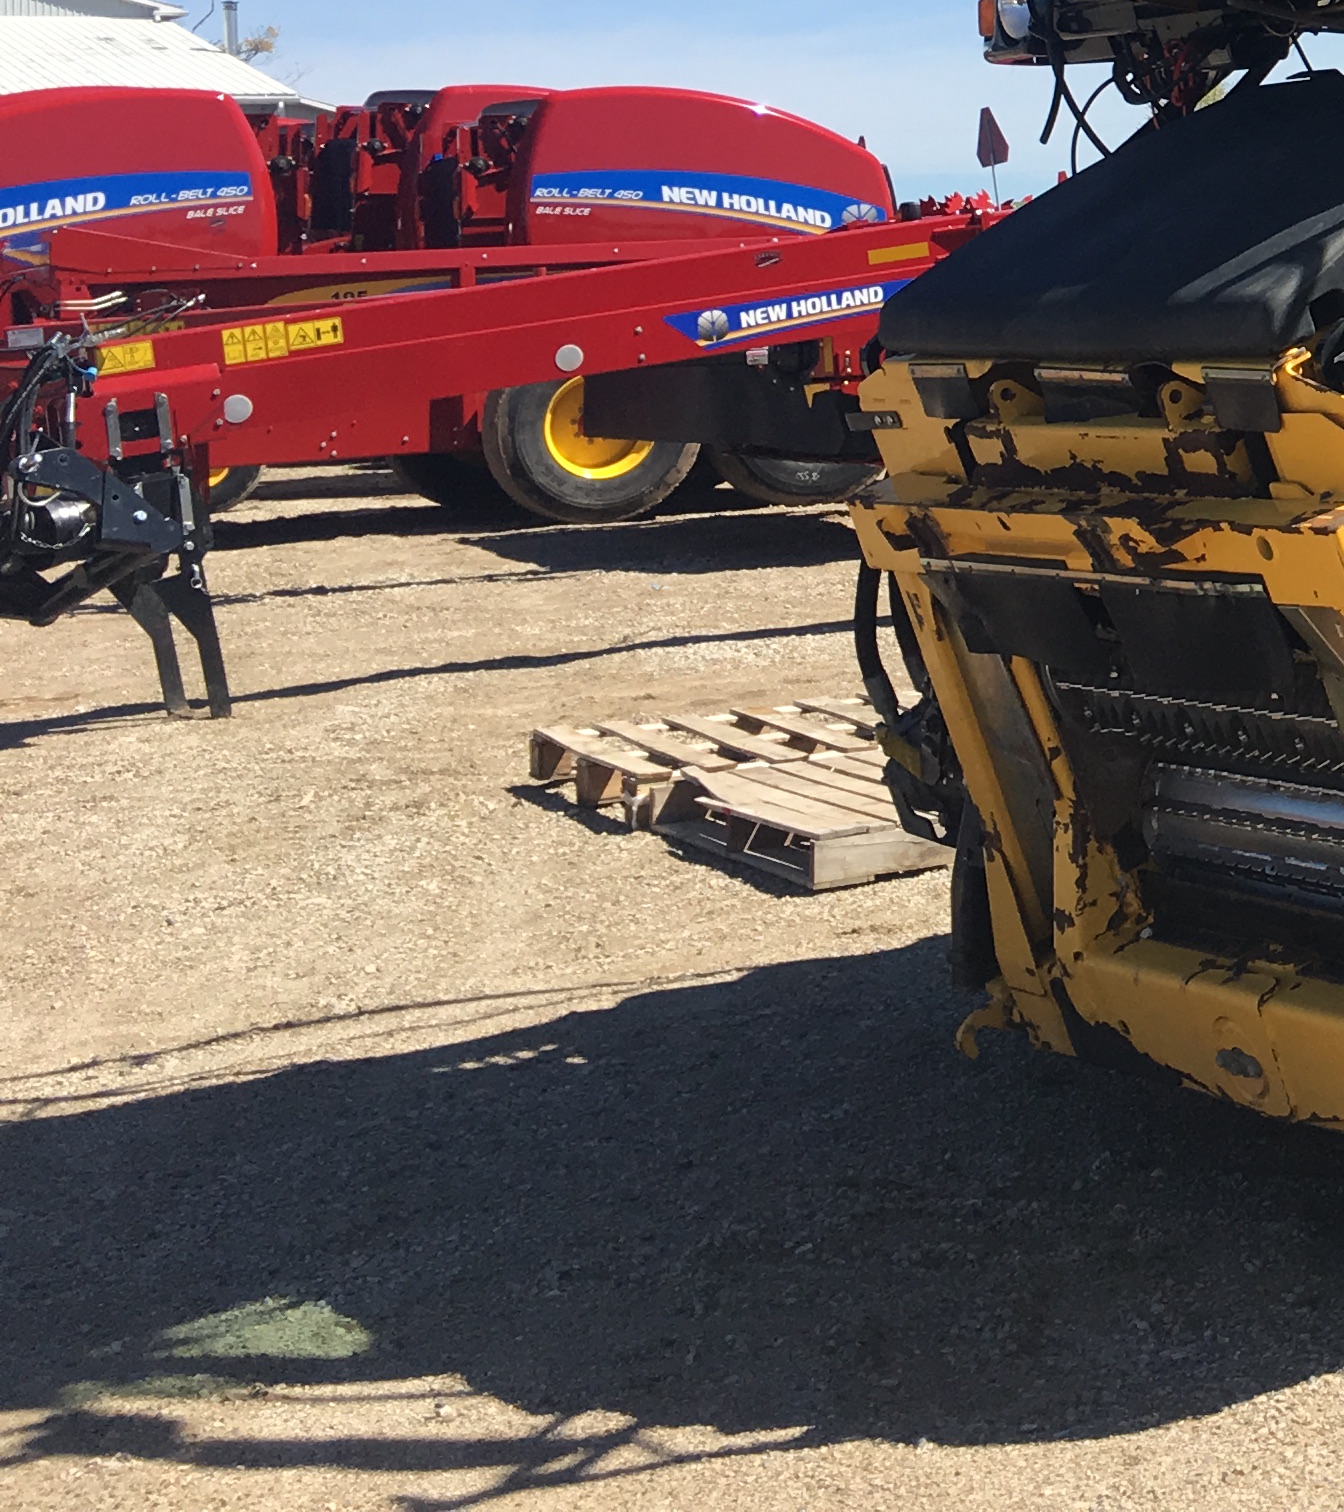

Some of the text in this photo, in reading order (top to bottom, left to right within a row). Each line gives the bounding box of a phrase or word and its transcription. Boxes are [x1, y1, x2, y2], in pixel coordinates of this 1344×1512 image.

[0, 185, 249, 228] OLLAND ROLL-BELT 450
[186, 205, 246, 219] BALE SLICE
[533, 185, 832, 229] ROLL-BELT 450 NEW HOLLAND
[535, 206, 562, 215] BALE
[740, 286, 884, 328] NEW HOLLAND
